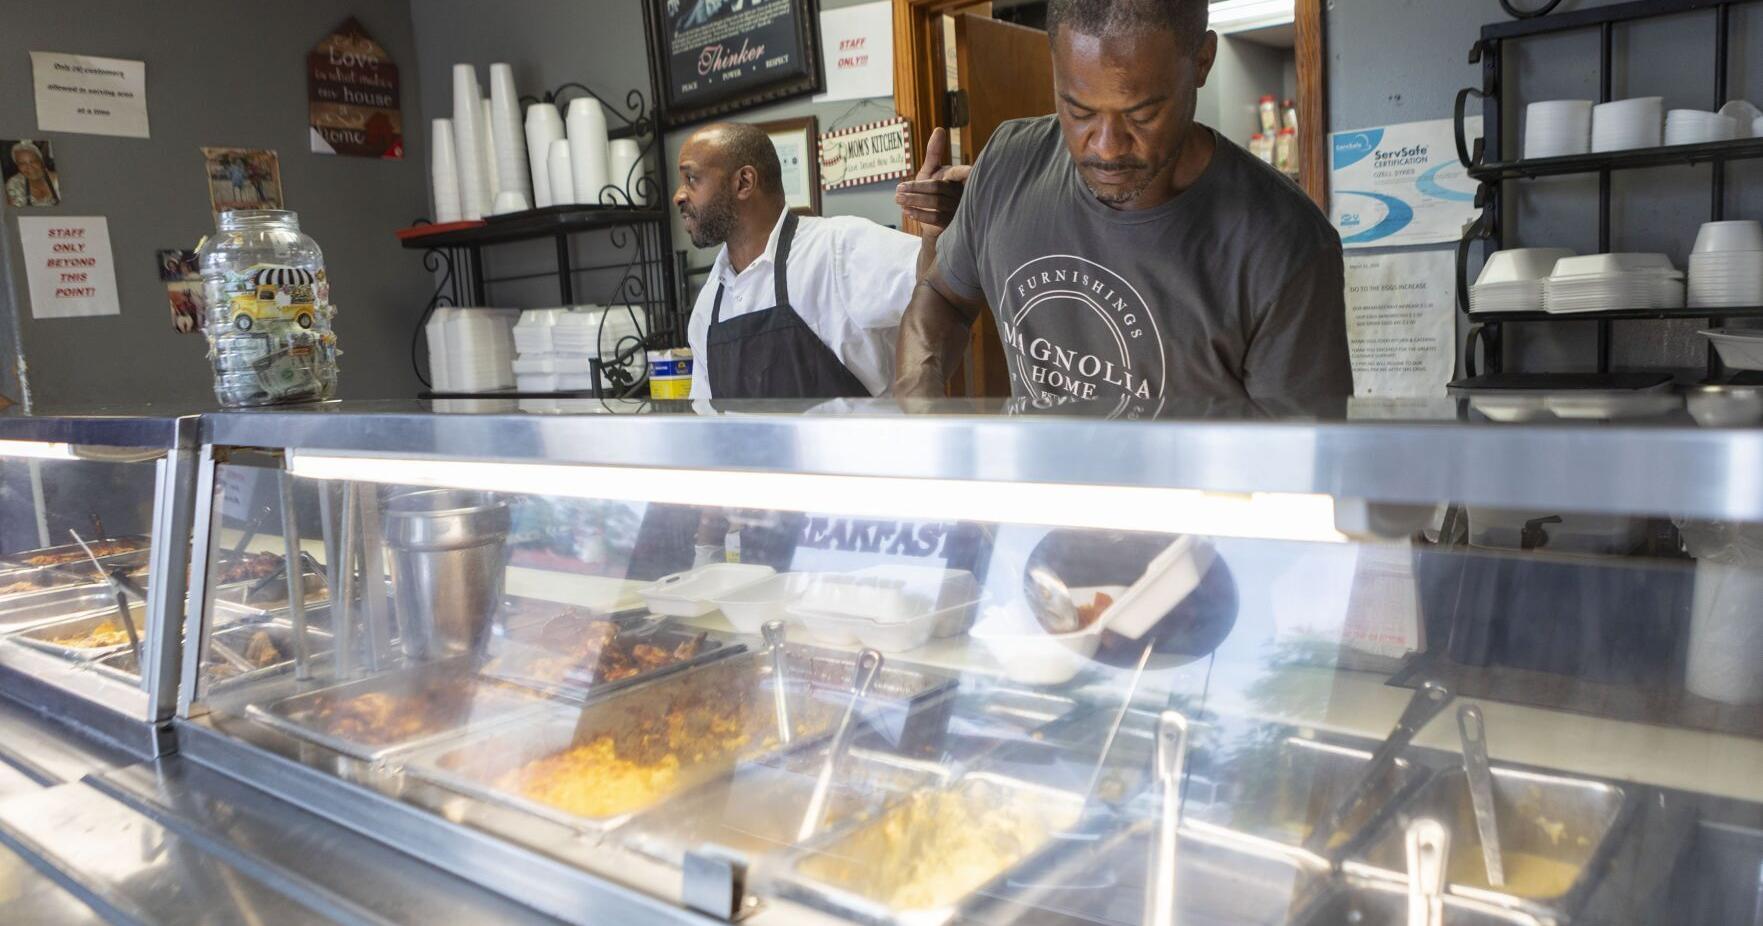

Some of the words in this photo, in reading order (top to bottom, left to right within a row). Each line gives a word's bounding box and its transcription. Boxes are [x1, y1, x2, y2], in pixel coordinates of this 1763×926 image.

[840, 38, 865, 50] STAFF
[329, 45, 379, 69] Love
[698, 38, 765, 75] Thinker
[343, 85, 392, 106] house
[848, 138, 869, 159] MOM'S
[872, 131, 903, 155] KITCHEN
[1375, 144, 1428, 160] ServSafe
[1374, 155, 1428, 168] CERTIFICATION
[48, 228, 85, 238] STAFF
[53, 243, 86, 253] ONLY
[47, 258, 96, 268] BEYOND
[60, 273, 88, 281] THIS
[1017, 269, 1143, 338] FURNISHINGS
[1003, 321, 1150, 400] MAGNOLIA
[1031, 365, 1097, 400] HOME
